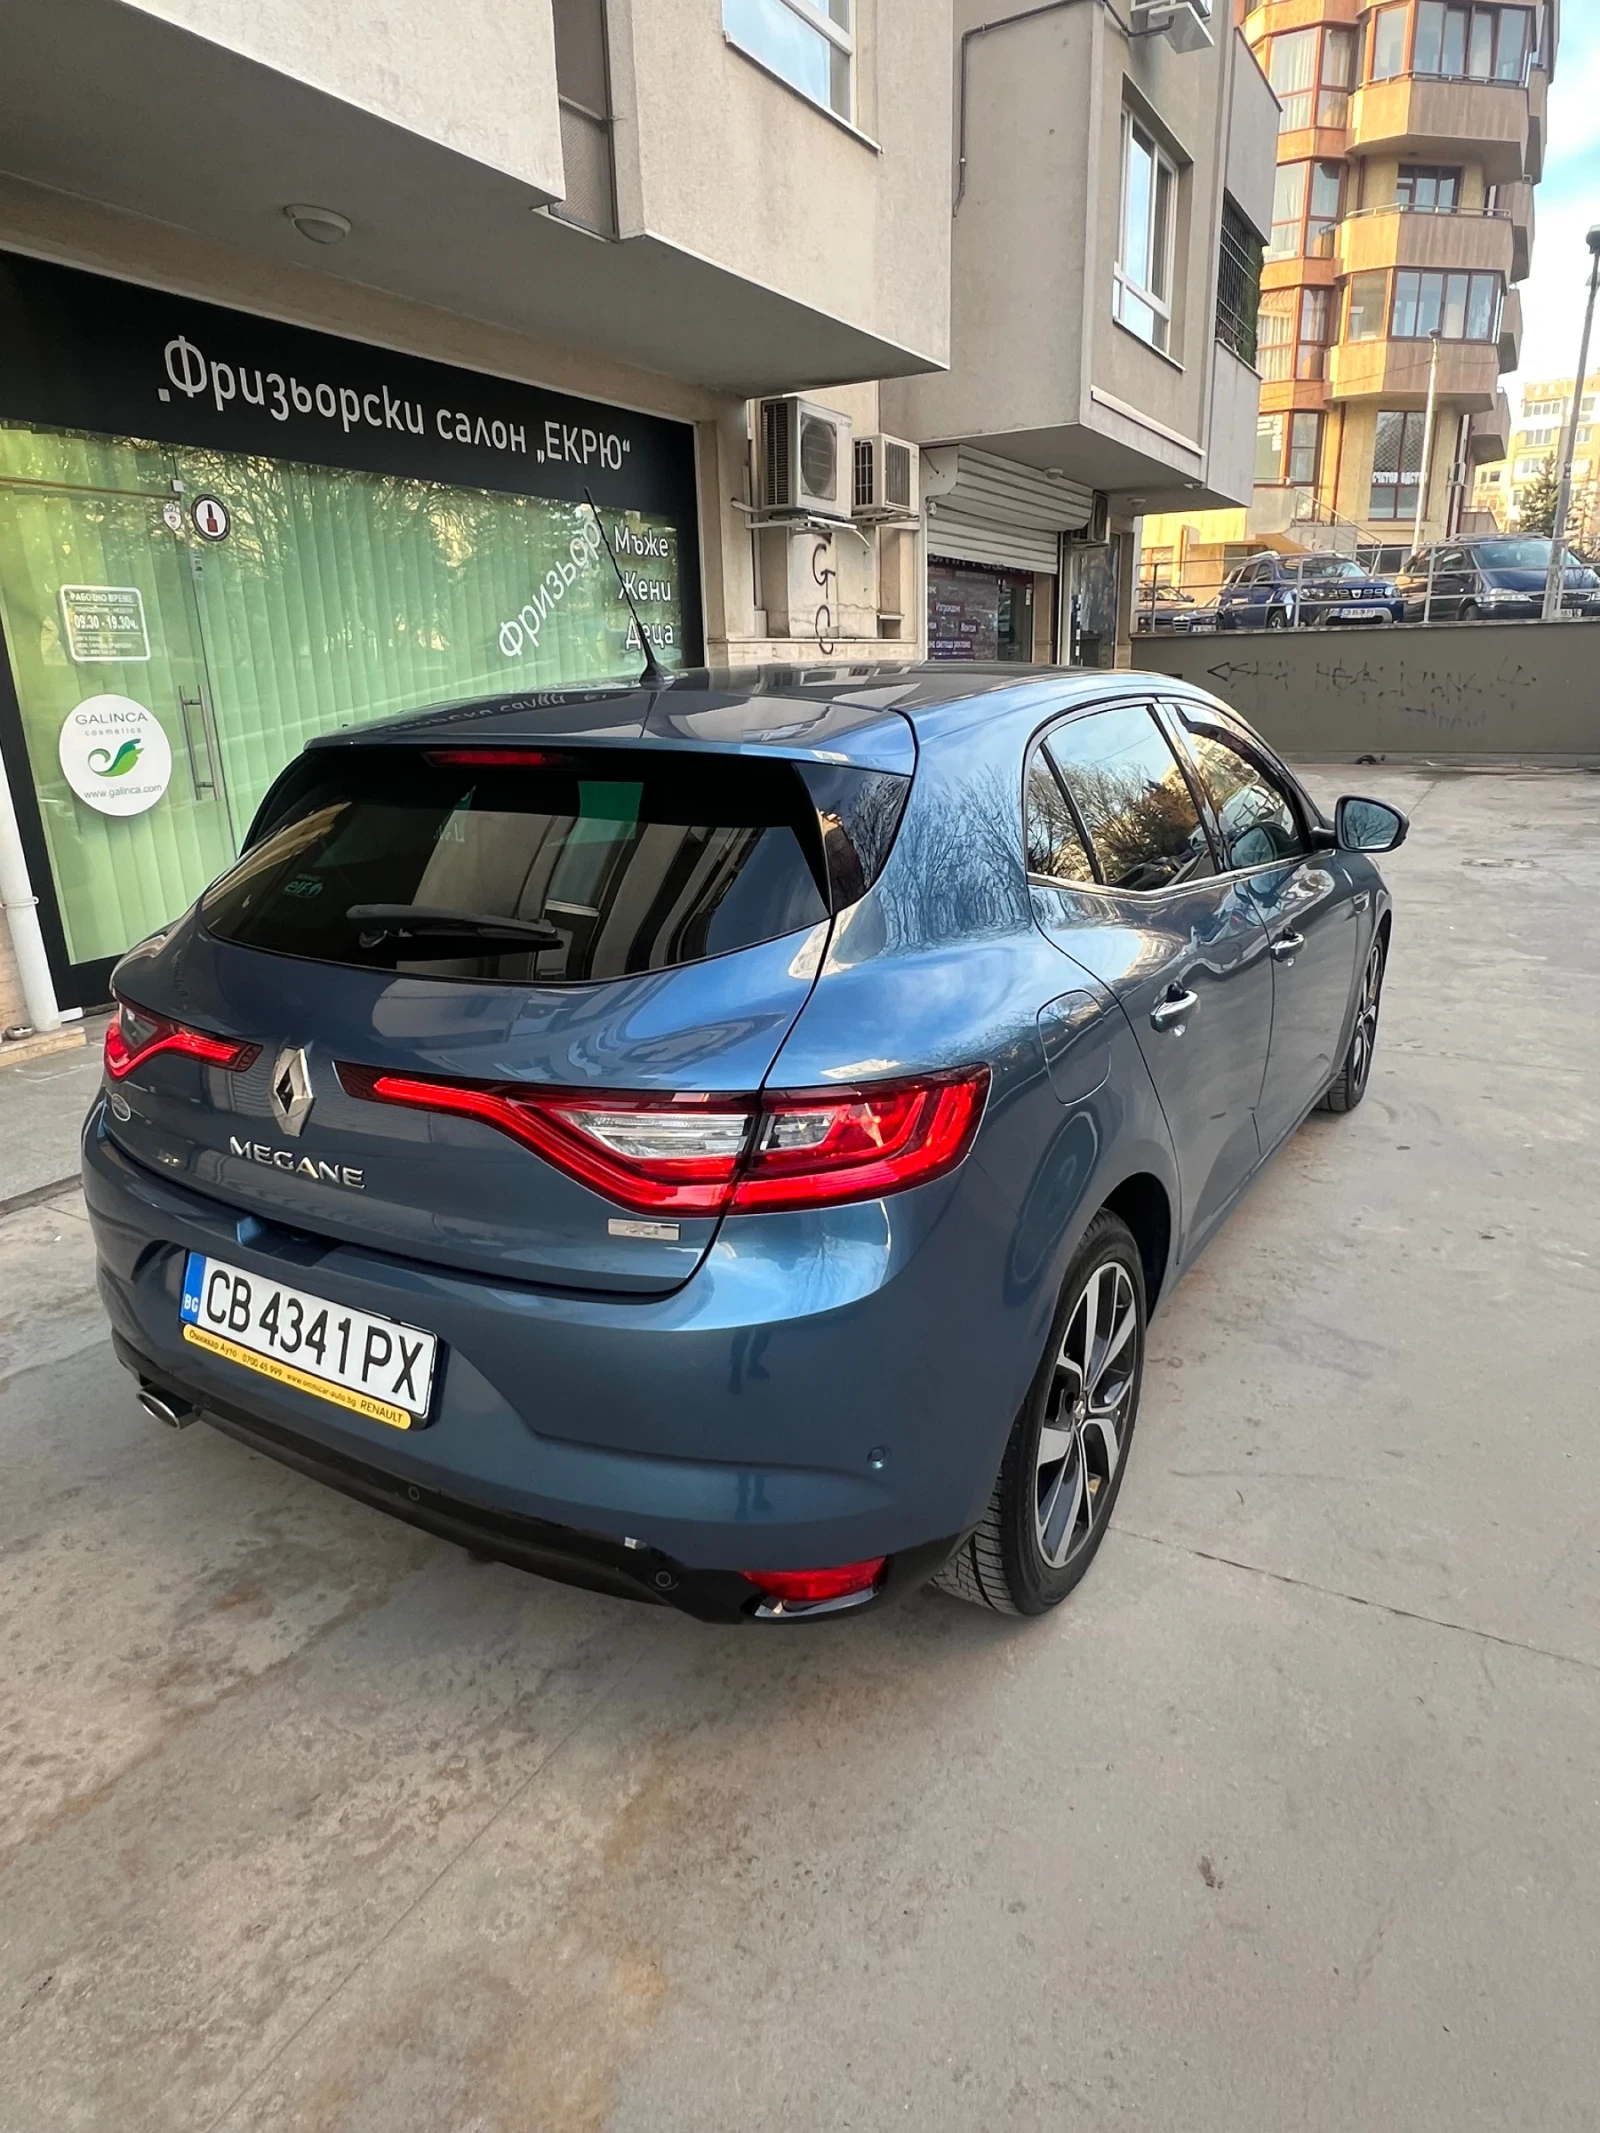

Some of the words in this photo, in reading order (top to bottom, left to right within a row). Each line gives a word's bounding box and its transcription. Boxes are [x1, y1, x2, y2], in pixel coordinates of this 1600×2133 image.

[436, 408, 527, 453] салон
[614, 525, 669, 557] Мъже
[499, 520, 601, 658] Фризьор
[618, 570, 671, 601] Жени
[625, 616, 674, 650] Деца
[75, 712, 149, 726] GALINCA
[84, 727, 142, 737] cosmetics
[83, 784, 163, 799] www.galinca.com
[229, 1136, 366, 1189] MEGANE
[183, 1293, 199, 1313] BG
[220, 1342, 238, 1358] Ауто
[360, 1399, 404, 1424] RENAULT
